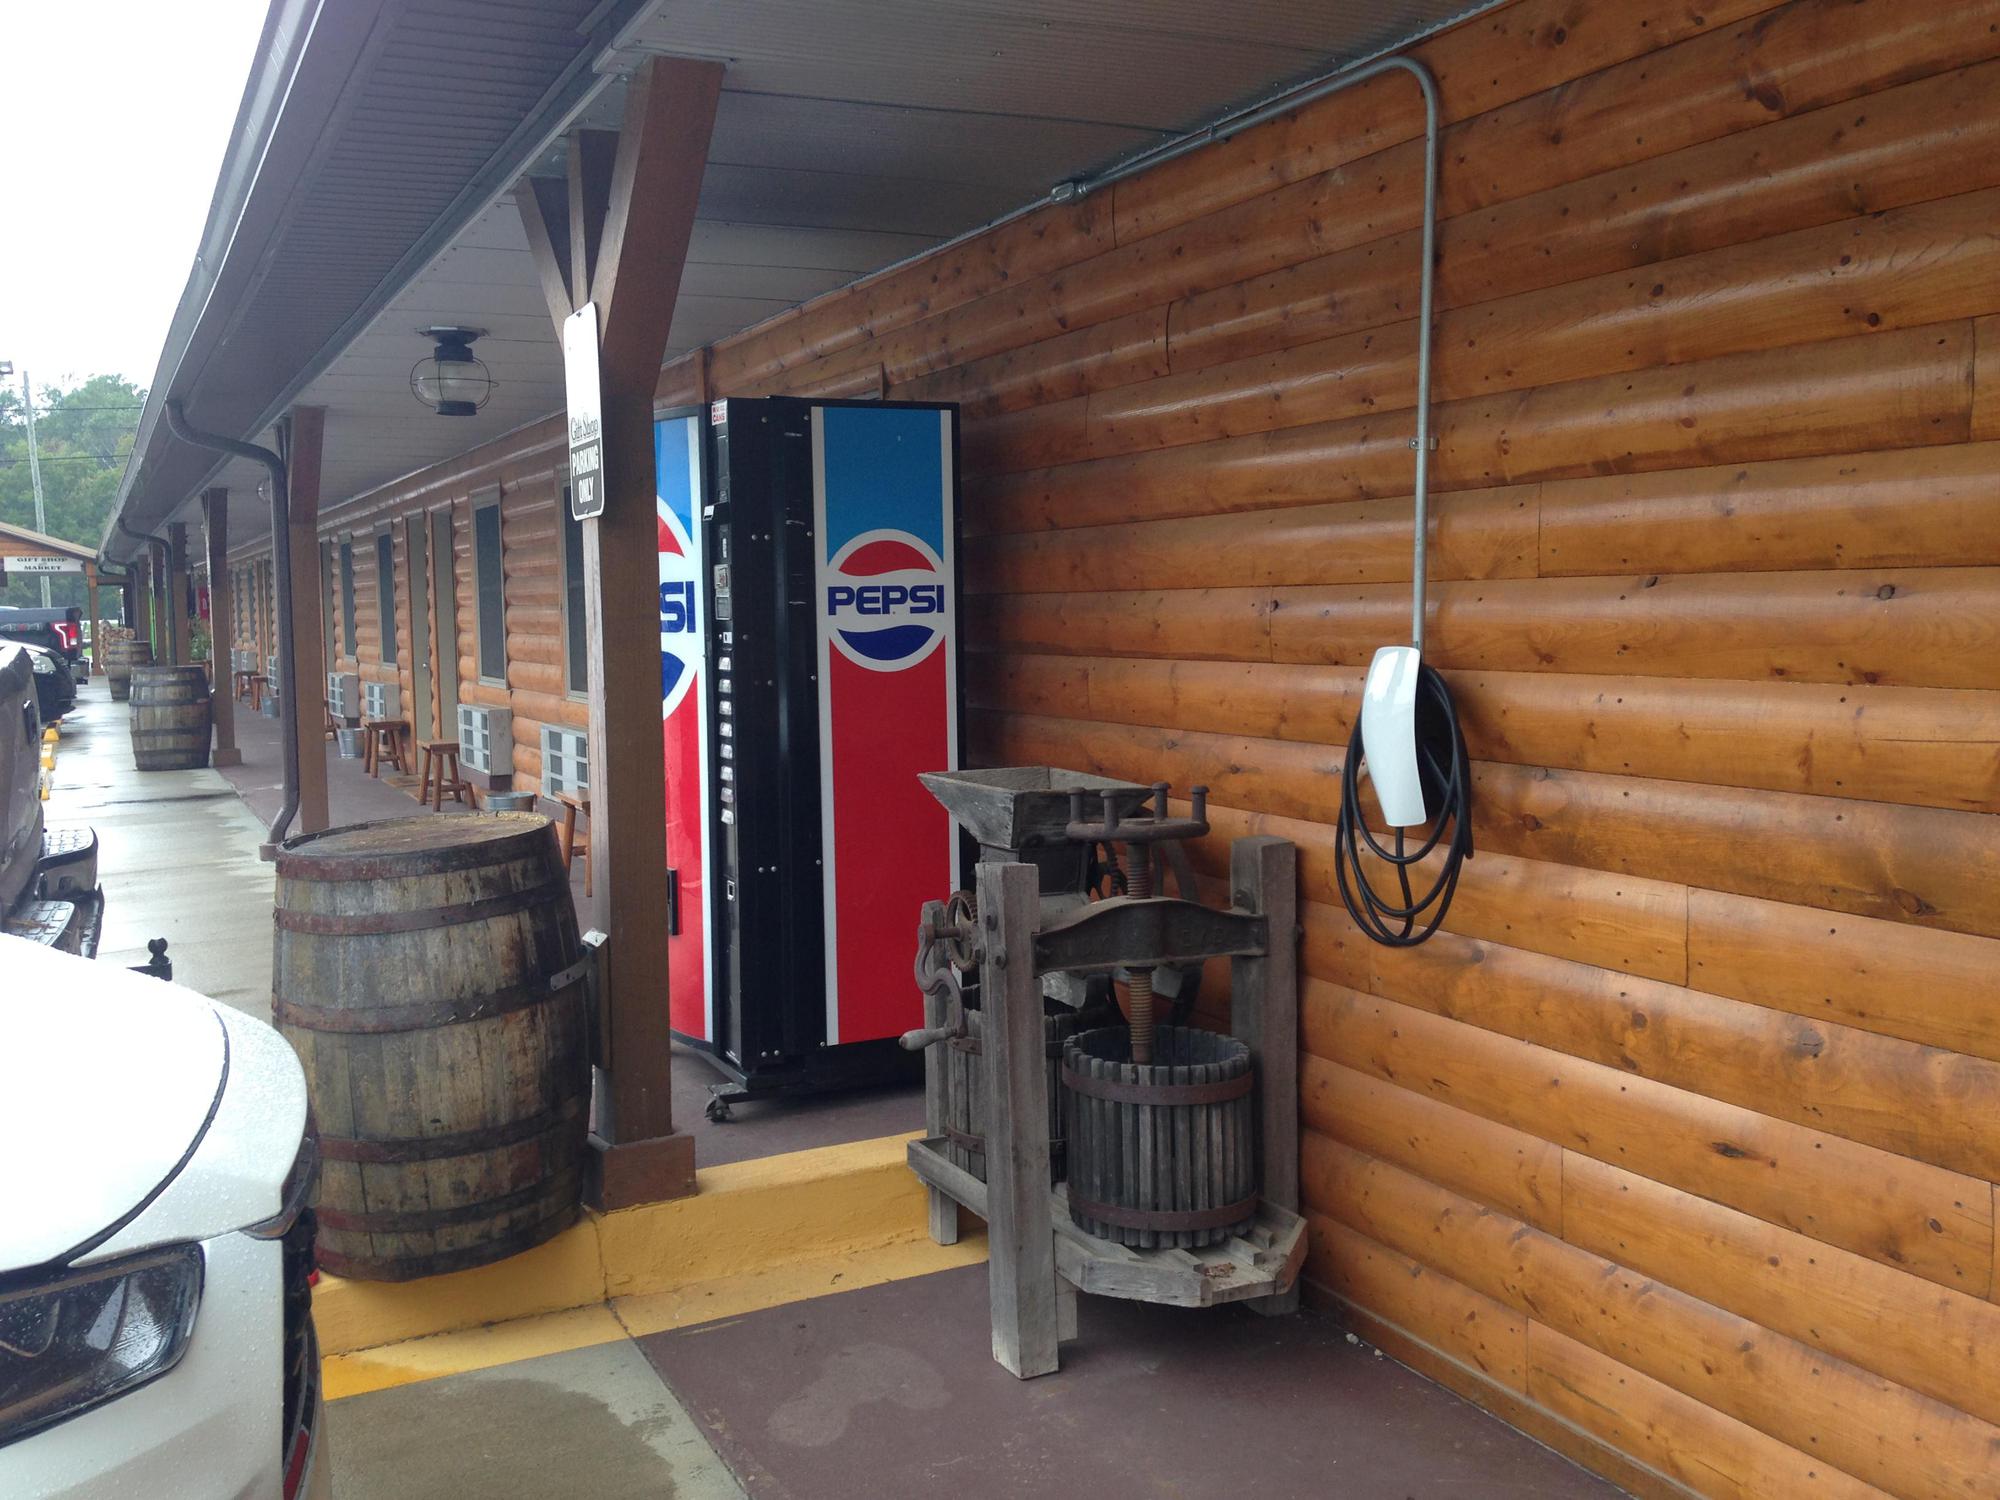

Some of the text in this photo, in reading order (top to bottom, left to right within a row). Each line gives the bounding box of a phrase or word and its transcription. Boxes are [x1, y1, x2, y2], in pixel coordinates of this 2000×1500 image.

[572, 445, 599, 476] PARKING
[579, 477, 594, 504] ONLY
[828, 584, 945, 616] PEPSI
